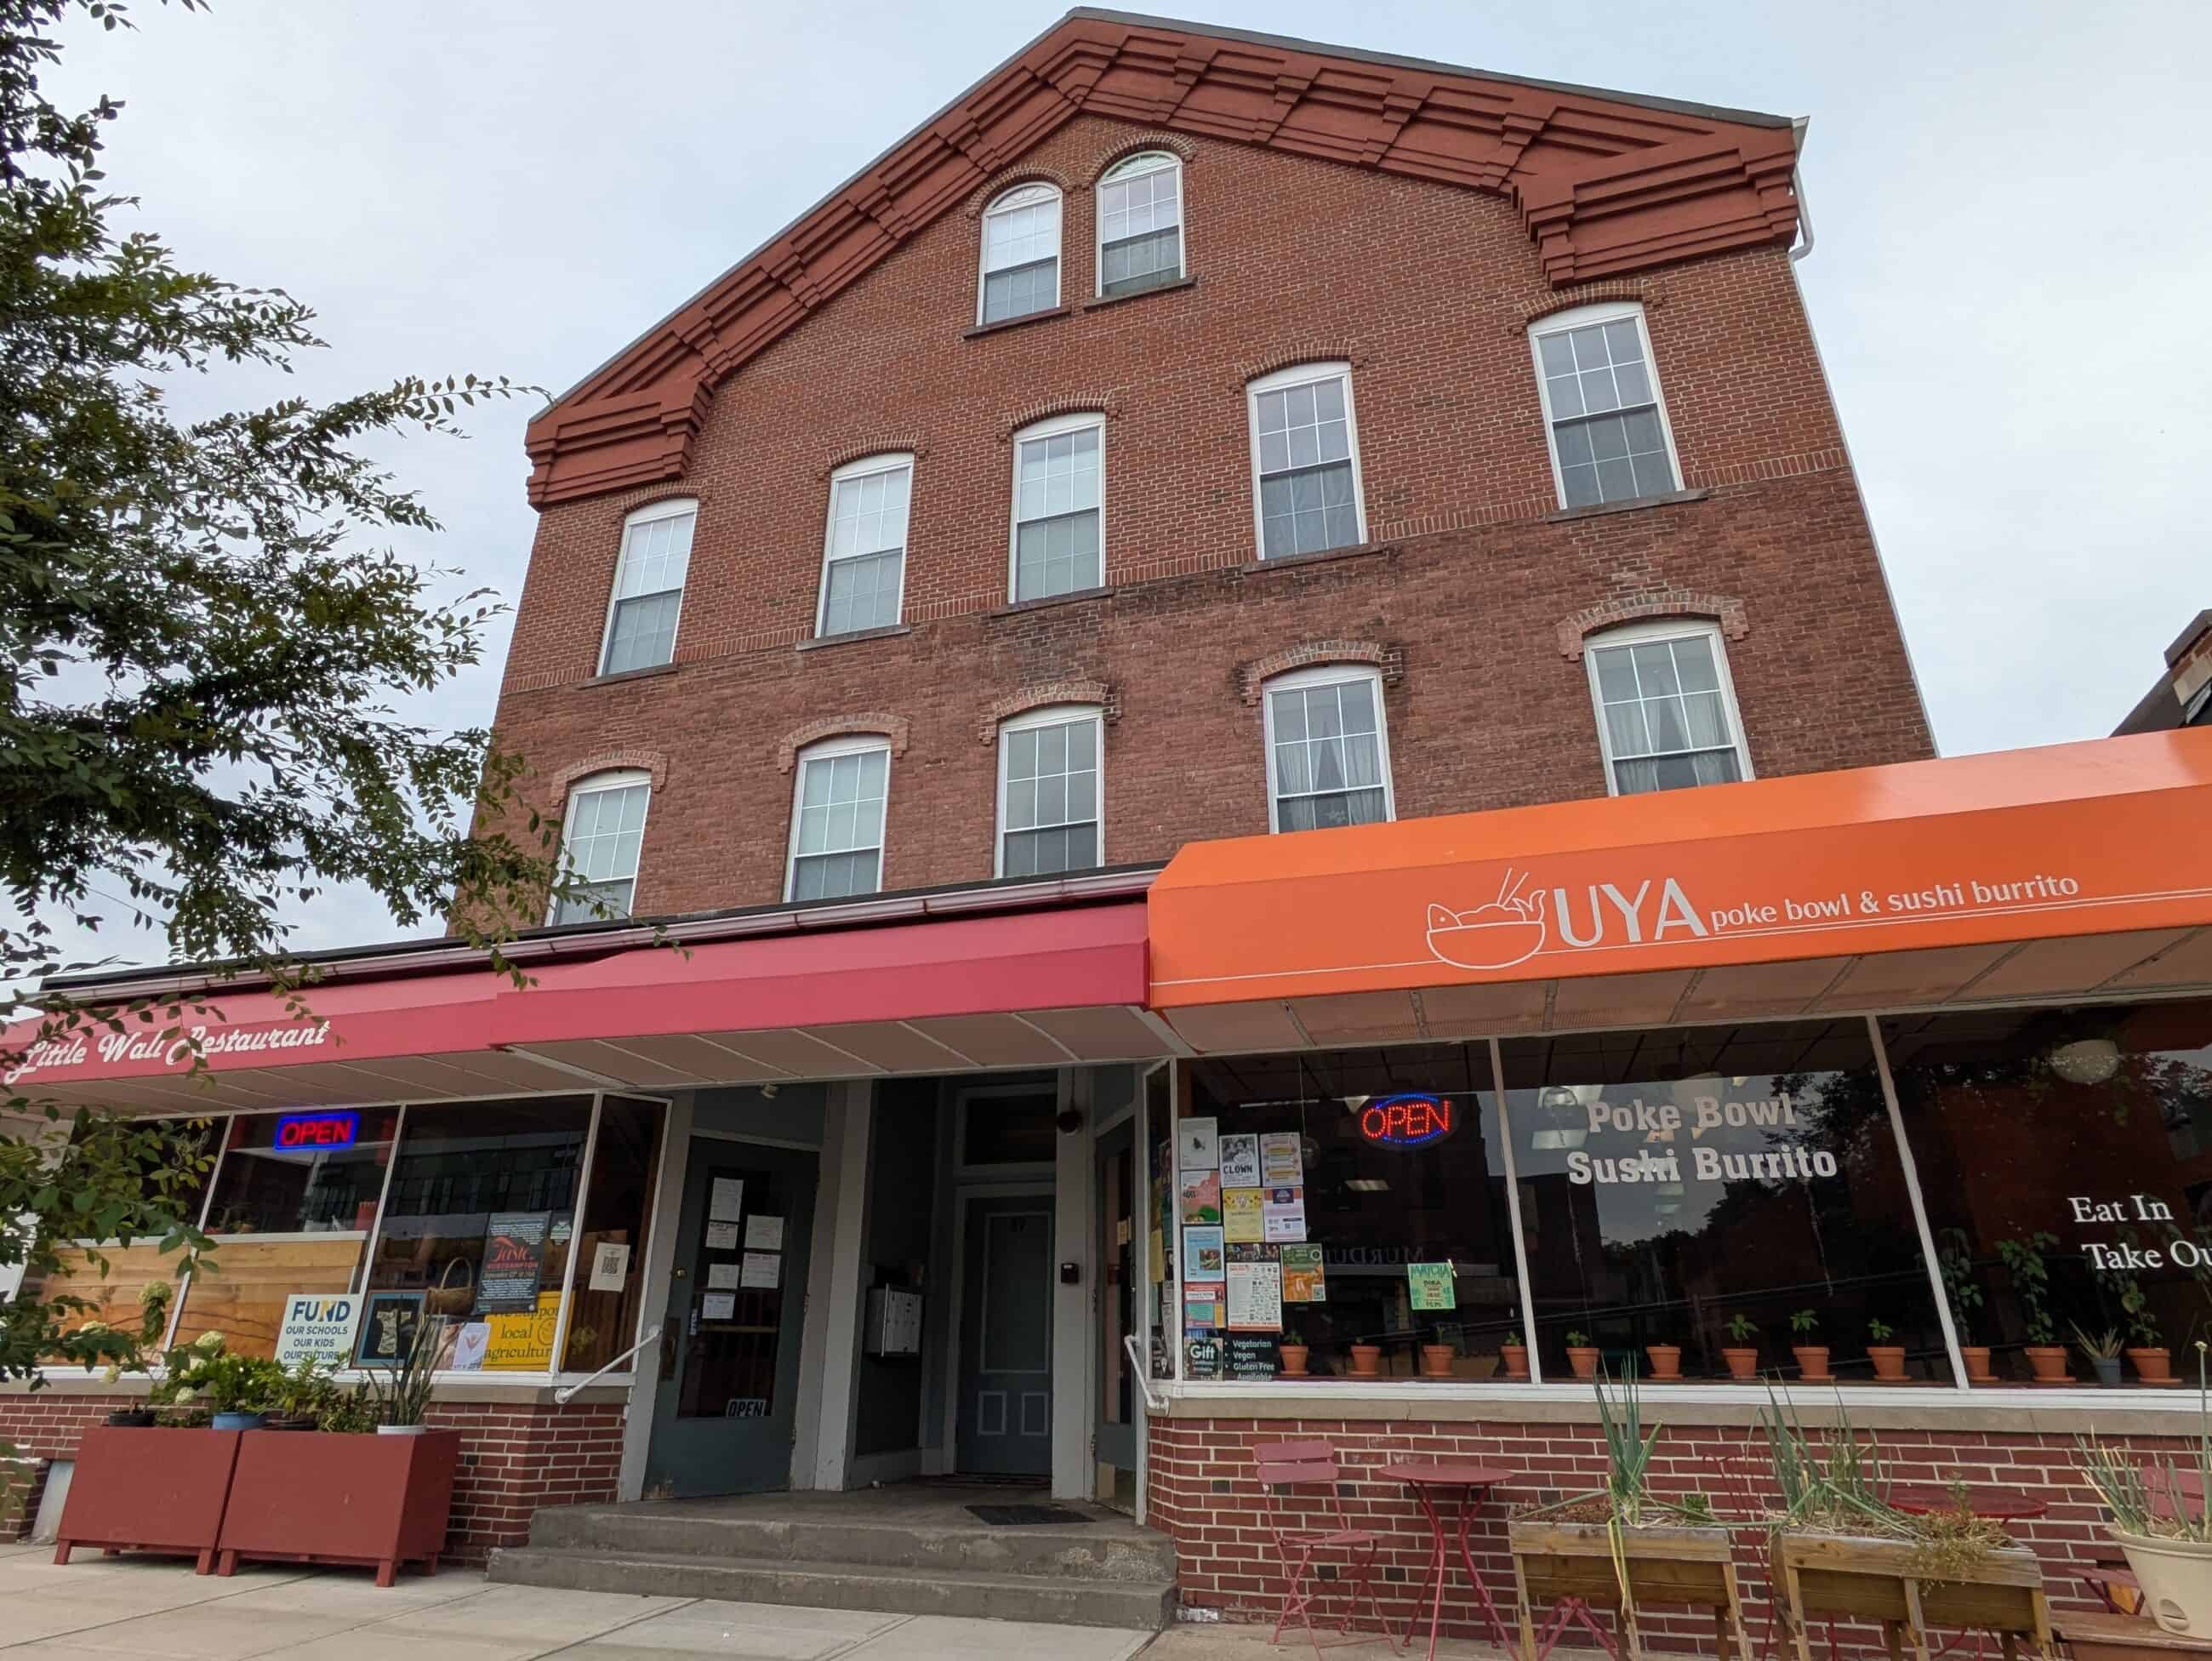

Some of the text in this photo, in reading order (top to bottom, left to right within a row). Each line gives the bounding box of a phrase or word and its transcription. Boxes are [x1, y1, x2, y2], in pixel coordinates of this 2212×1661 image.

[1554, 878, 1708, 947] UYA
[1711, 875, 2078, 932] poke bowl & sushi burrito
[3, 1037, 88, 1085] Little
[166, 1020, 330, 1066] Restaurant
[1362, 1099, 1451, 1138] OPEN
[1586, 1093, 1797, 1133] Poke Bowl
[280, 1117, 353, 1145] OPEN
[1223, 1164, 1253, 1174] CLOWN
[1566, 1144, 1838, 1184] Sushi Burrito
[2067, 1195, 2175, 1223] Eat In
[2081, 1240, 2212, 1270] Take Ou
[292, 1300, 351, 1321] FUND
[286, 1326, 348, 1335] OUR SCHOOLS
[501, 1322, 533, 1339] local
[294, 1339, 335, 1347] OUR KIDS
[1232, 1339, 1272, 1350] Vegetarian
[283, 1350, 302, 1360] OUR
[1233, 1351, 1256, 1361] Vegan
[1233, 1361, 1275, 1371] Gluten Free
[728, 1401, 763, 1417] OPEN
